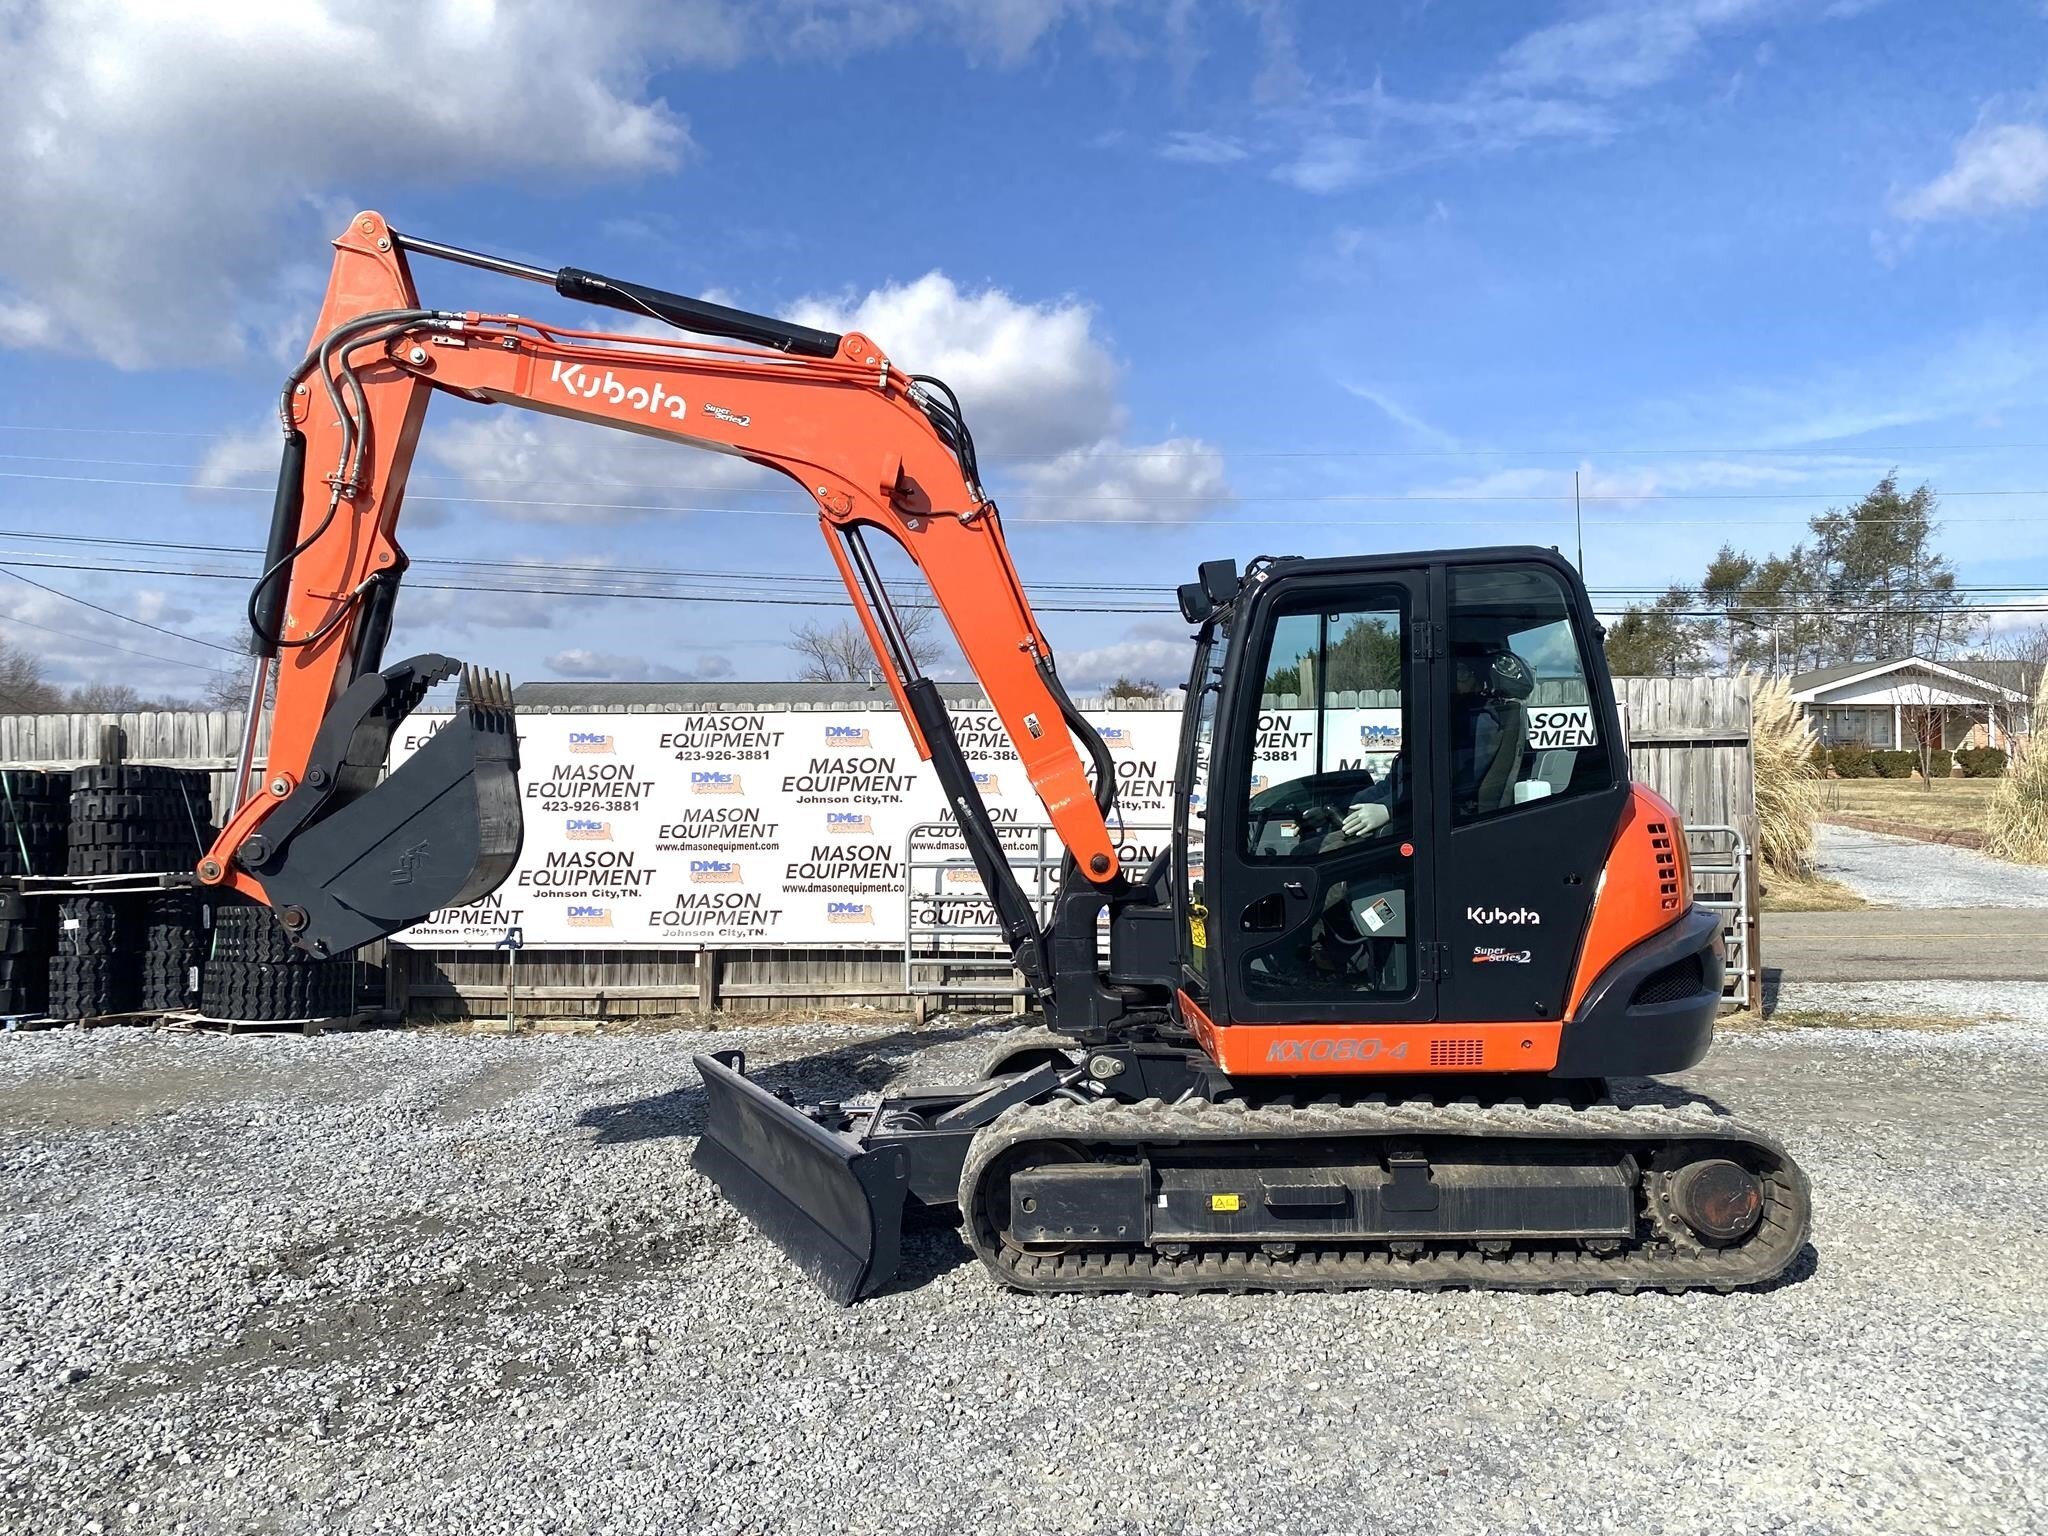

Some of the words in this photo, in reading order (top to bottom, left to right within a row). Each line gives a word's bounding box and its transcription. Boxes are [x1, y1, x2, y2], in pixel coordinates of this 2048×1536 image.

[551, 360, 687, 420] Kubota
[703, 403, 732, 415] Super
[685, 716, 764, 731] MASON
[660, 733, 784, 748] EQUIPMENT
[675, 751, 769, 760] 423-926-3881
[553, 765, 634, 780] MASON
[809, 758, 895, 774] MASON
[527, 782, 655, 798] EQUIPMENT
[782, 776, 917, 792] EQUIPMENT
[542, 801, 639, 811] 423-926-3881
[854, 795, 902, 804] City,TN.
[683, 808, 759, 822] MASON
[659, 824, 778, 838] EQUIPMENT
[656, 842, 779, 852] www.dmasonequipment.com
[811, 846, 891, 861] MASON
[546, 852, 634, 867] MASON
[518, 870, 656, 886] EQUIPMENT
[592, 889, 641, 899] City,TN.
[676, 894, 761, 908] MASON
[649, 911, 782, 926] EQUIPMENT
[1467, 907, 1540, 924] Kubota
[663, 929, 714, 937] Johnson
[719, 929, 767, 937] City,TN.
[1474, 947, 1505, 957] Super
[1266, 1039, 1408, 1062] KX080-4
